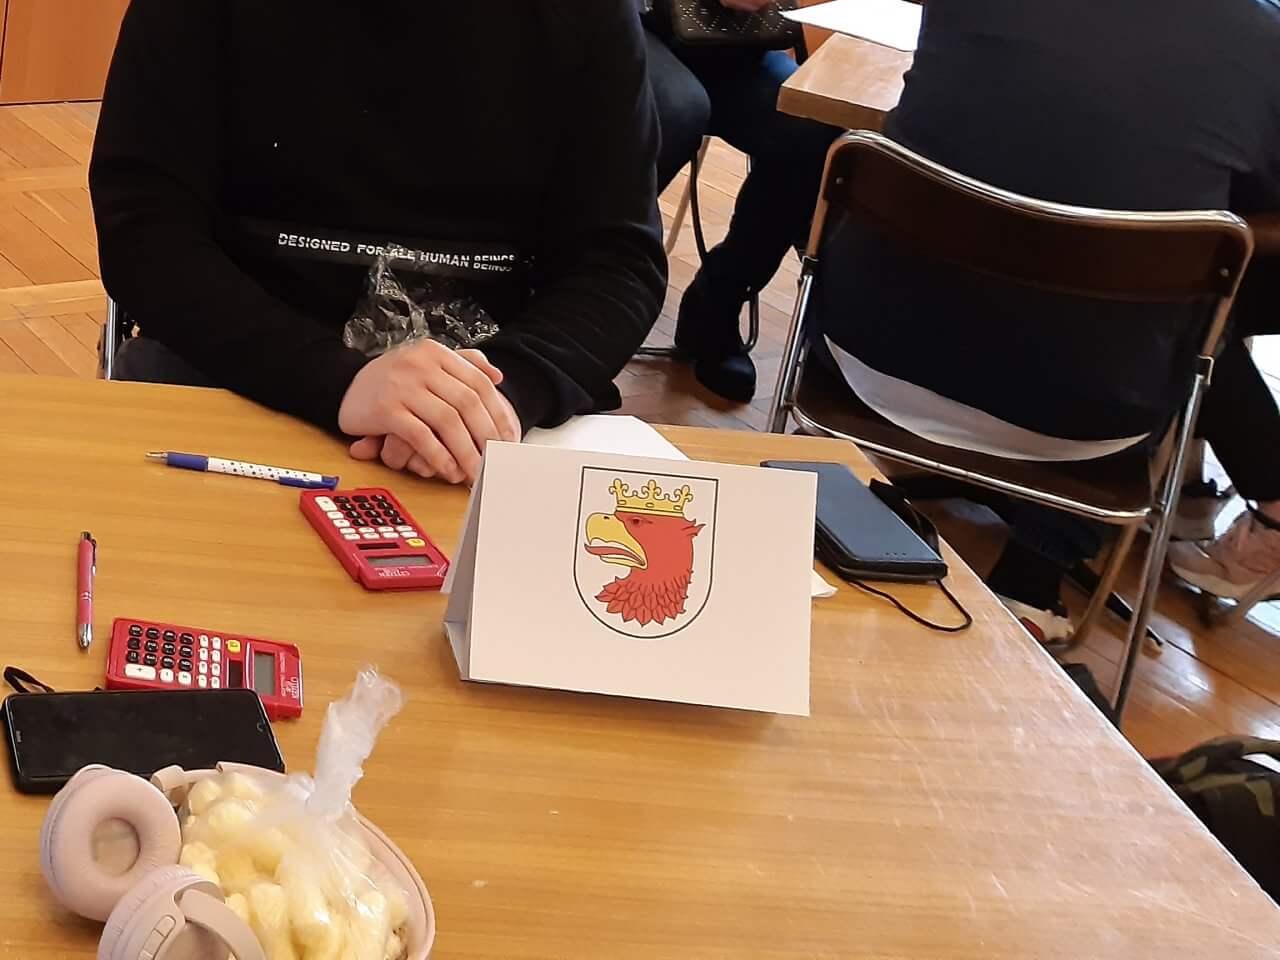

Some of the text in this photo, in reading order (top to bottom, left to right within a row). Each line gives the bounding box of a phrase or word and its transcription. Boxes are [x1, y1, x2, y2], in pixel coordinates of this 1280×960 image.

[278, 232, 351, 252] DESIGNED
[357, 244, 385, 256] FOR
[420, 251, 470, 268] HUMAN
